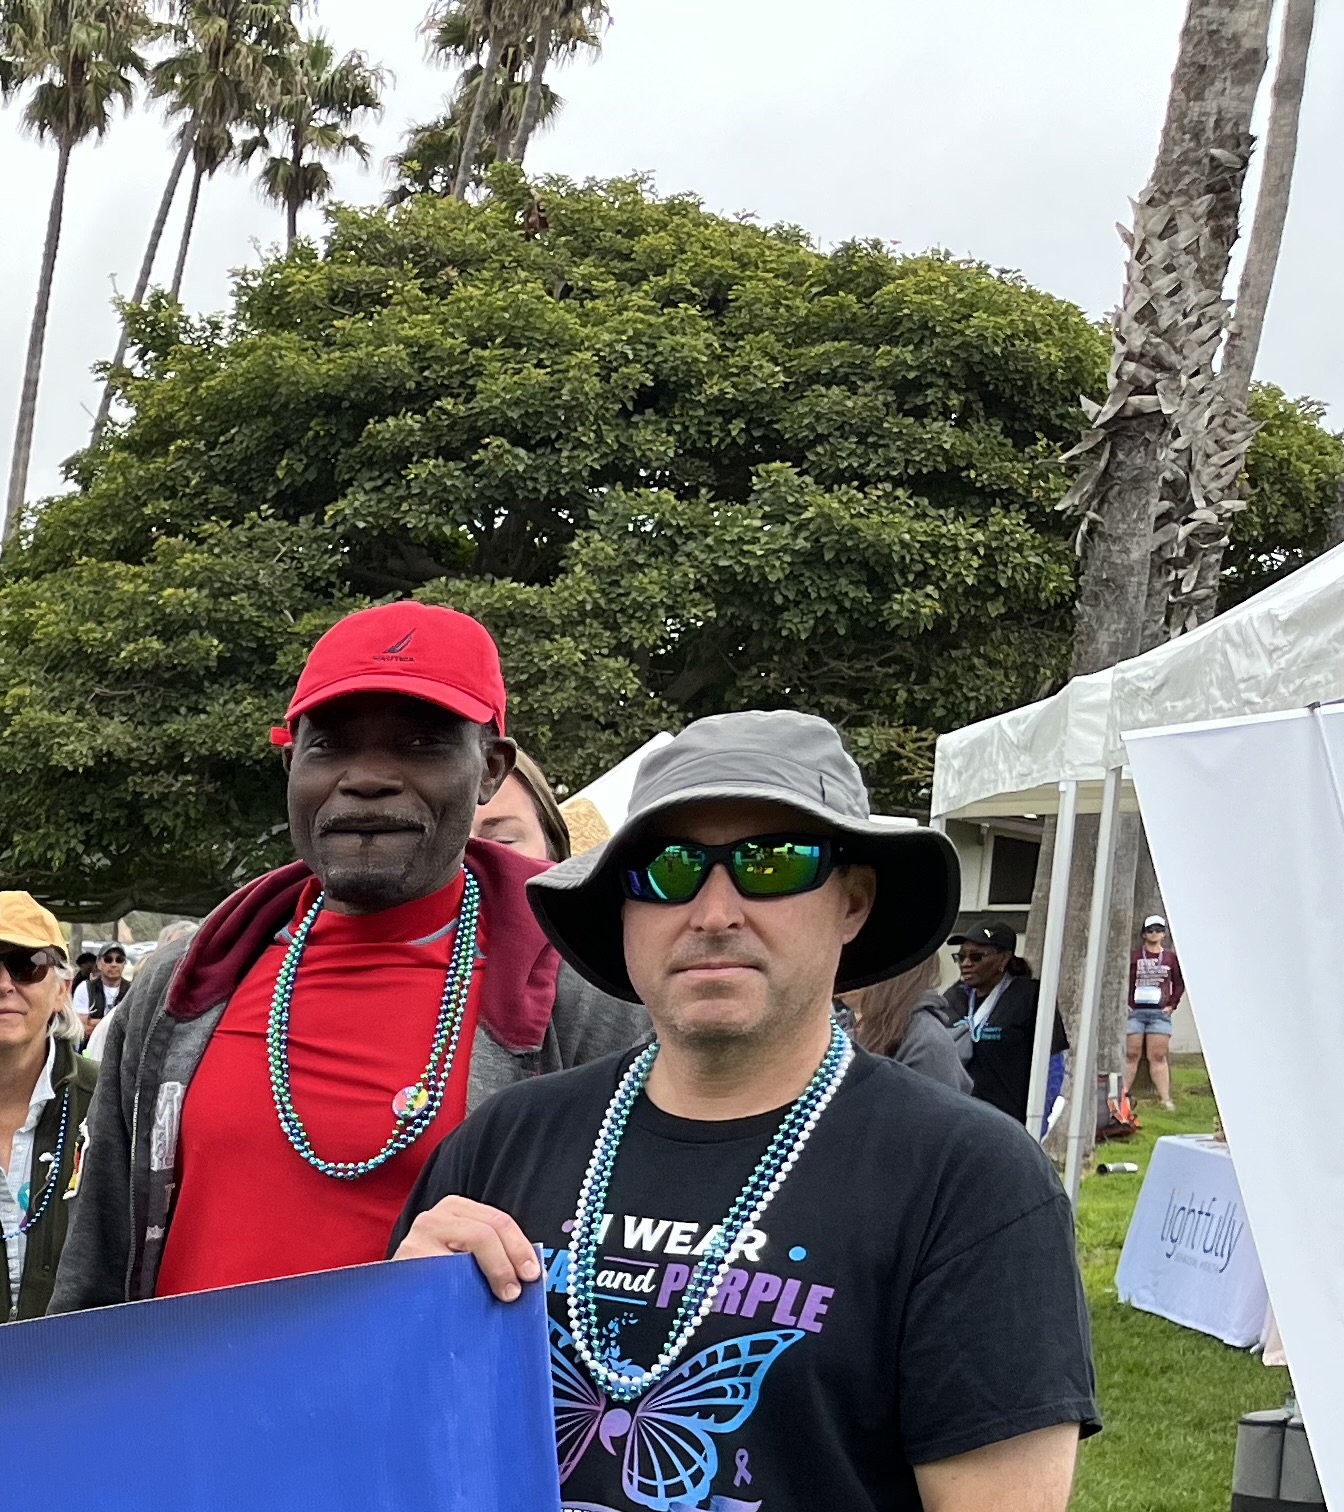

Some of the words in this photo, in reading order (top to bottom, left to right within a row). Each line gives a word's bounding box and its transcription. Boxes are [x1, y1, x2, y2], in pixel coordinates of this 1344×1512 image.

[1160, 1188, 1244, 1273] lightfully
[597, 1268, 657, 1293] and
[656, 1263, 835, 1333] PRPLE
